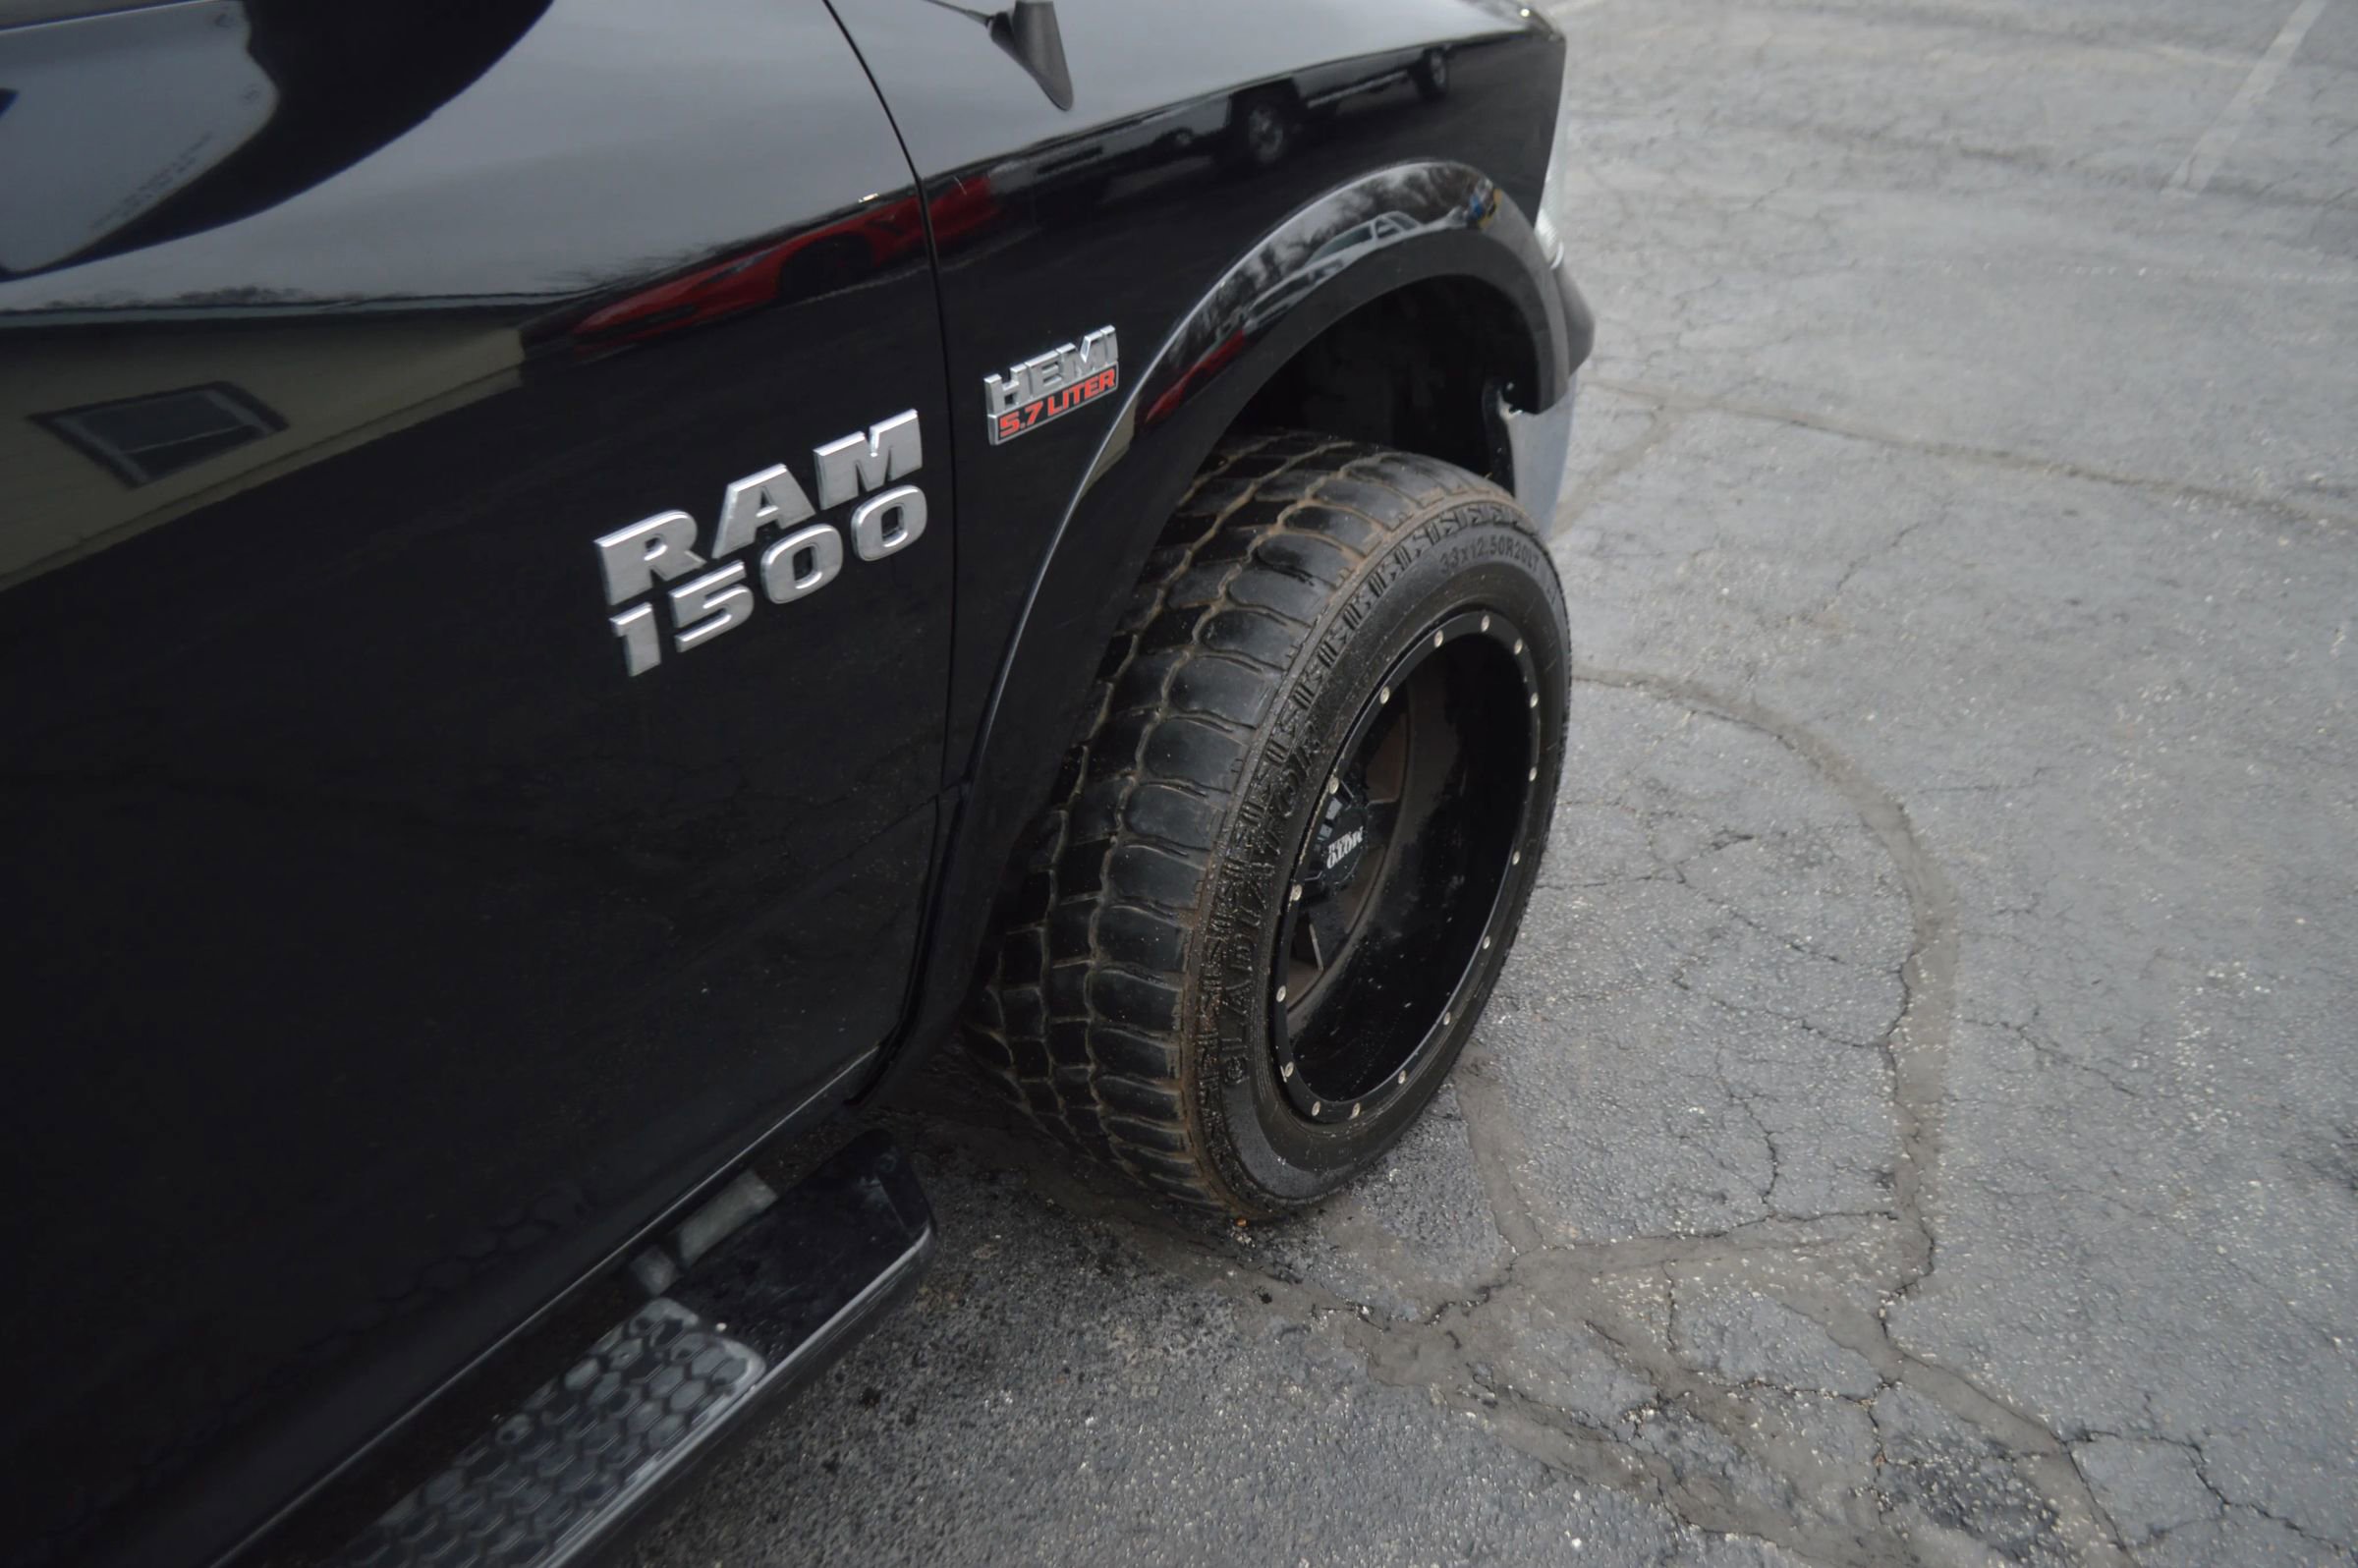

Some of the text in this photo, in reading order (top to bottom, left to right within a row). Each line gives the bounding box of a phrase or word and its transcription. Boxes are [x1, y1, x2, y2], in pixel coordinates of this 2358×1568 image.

[983, 324, 1119, 417] HEMI
[1000, 368, 1115, 437] 5.7 LITER
[594, 409, 923, 605] RAM
[609, 485, 927, 676] 1500
